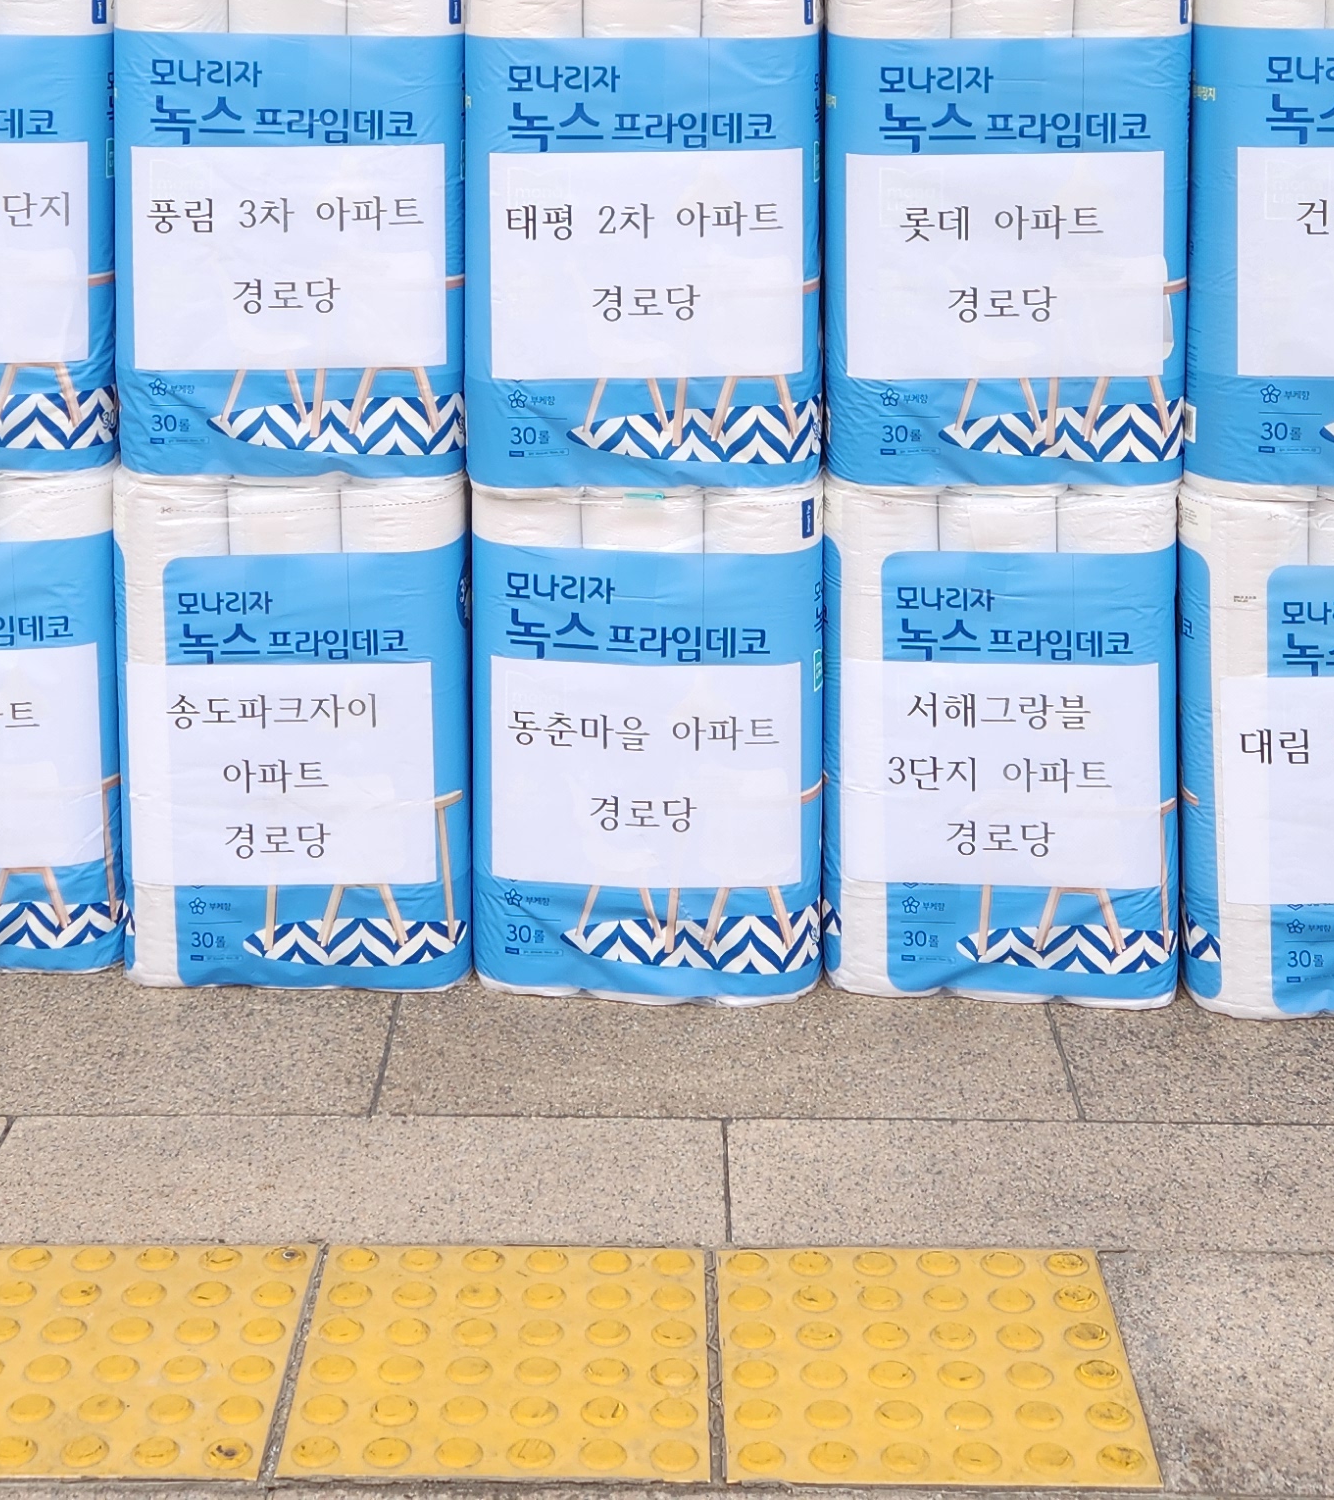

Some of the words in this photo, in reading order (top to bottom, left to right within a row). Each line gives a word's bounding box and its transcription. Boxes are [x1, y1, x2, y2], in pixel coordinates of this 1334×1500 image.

[146, 196, 215, 235] 풍림
[239, 198, 295, 234] 3차
[316, 196, 425, 231] 아파트
[506, 202, 575, 242] 태평
[598, 202, 655, 240] 2차
[675, 201, 785, 239] 아파트
[899, 205, 971, 245] 롯데
[993, 205, 1104, 242] 아파트
[232, 277, 341, 315] 경로당
[591, 284, 701, 324] 경로당
[947, 285, 1058, 324] 경로당
[166, 692, 379, 732] 송도파크자이
[507, 710, 650, 752] 동춘마을
[672, 714, 780, 751] 아파트
[906, 694, 1092, 732] 서해그랑블
[1239, 728, 1311, 766] 대림
[222, 759, 330, 794] 아파트
[887, 756, 979, 795] 3단지
[1002, 758, 1113, 793] 아파트
[590, 795, 698, 833] 경로당
[224, 822, 331, 860] 경로당
[946, 820, 1056, 858] 경로당
